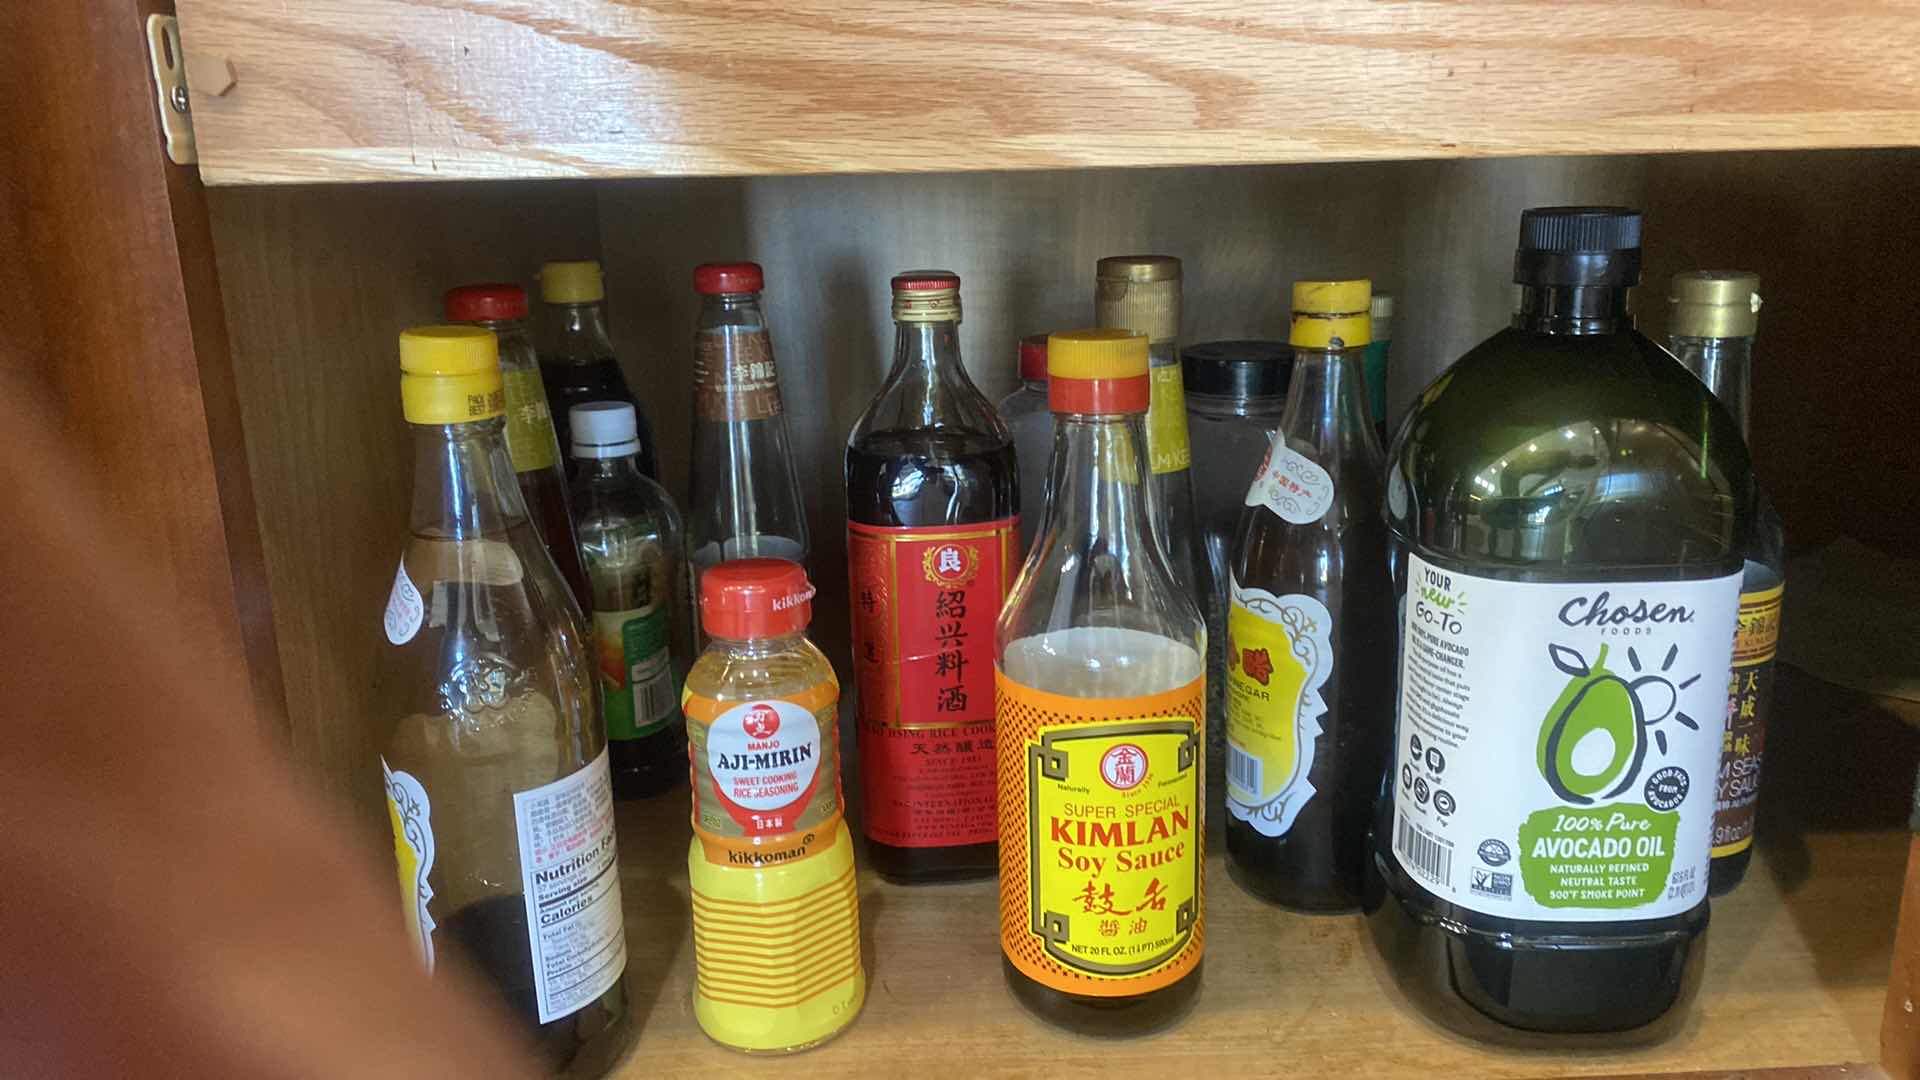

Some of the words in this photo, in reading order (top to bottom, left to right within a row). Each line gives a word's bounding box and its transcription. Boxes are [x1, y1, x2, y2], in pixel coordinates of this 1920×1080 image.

[938, 548, 961, 573] 良
[1424, 567, 1451, 592] YOUR
[1558, 591, 1695, 627] Chosen
[717, 741, 812, 770] AJI-MIRIN
[747, 740, 780, 751] MANJO
[733, 776, 761, 786] SWEET
[762, 771, 799, 785] COOKING
[1057, 783, 1091, 795] Naturally
[733, 787, 753, 799] RICE
[1064, 802, 1117, 819] SUPER
[1124, 794, 1180, 818] SPECIAL
[1050, 804, 1190, 848] KIMLAN
[1552, 813, 1603, 833] 100%
[1604, 812, 1652, 832] Pure
[1531, 836, 1632, 859] AVOCADO
[1636, 835, 1665, 858] OIL
[535, 847, 600, 885] Nutrition
[1058, 847, 1106, 878] Soy
[1116, 841, 1185, 872] Sauce
[1550, 863, 1607, 875] NATURALLY
[1608, 862, 1650, 874] REFINED
[1560, 876, 1605, 887] NEUTRAL
[1608, 875, 1638, 886] TASTE
[1580, 888, 1614, 899] SMOKE
[1615, 887, 1646, 899] POINT
[540, 895, 593, 924] Calories
[1071, 943, 1088, 954] NET
[1102, 945, 1112, 956] FL
